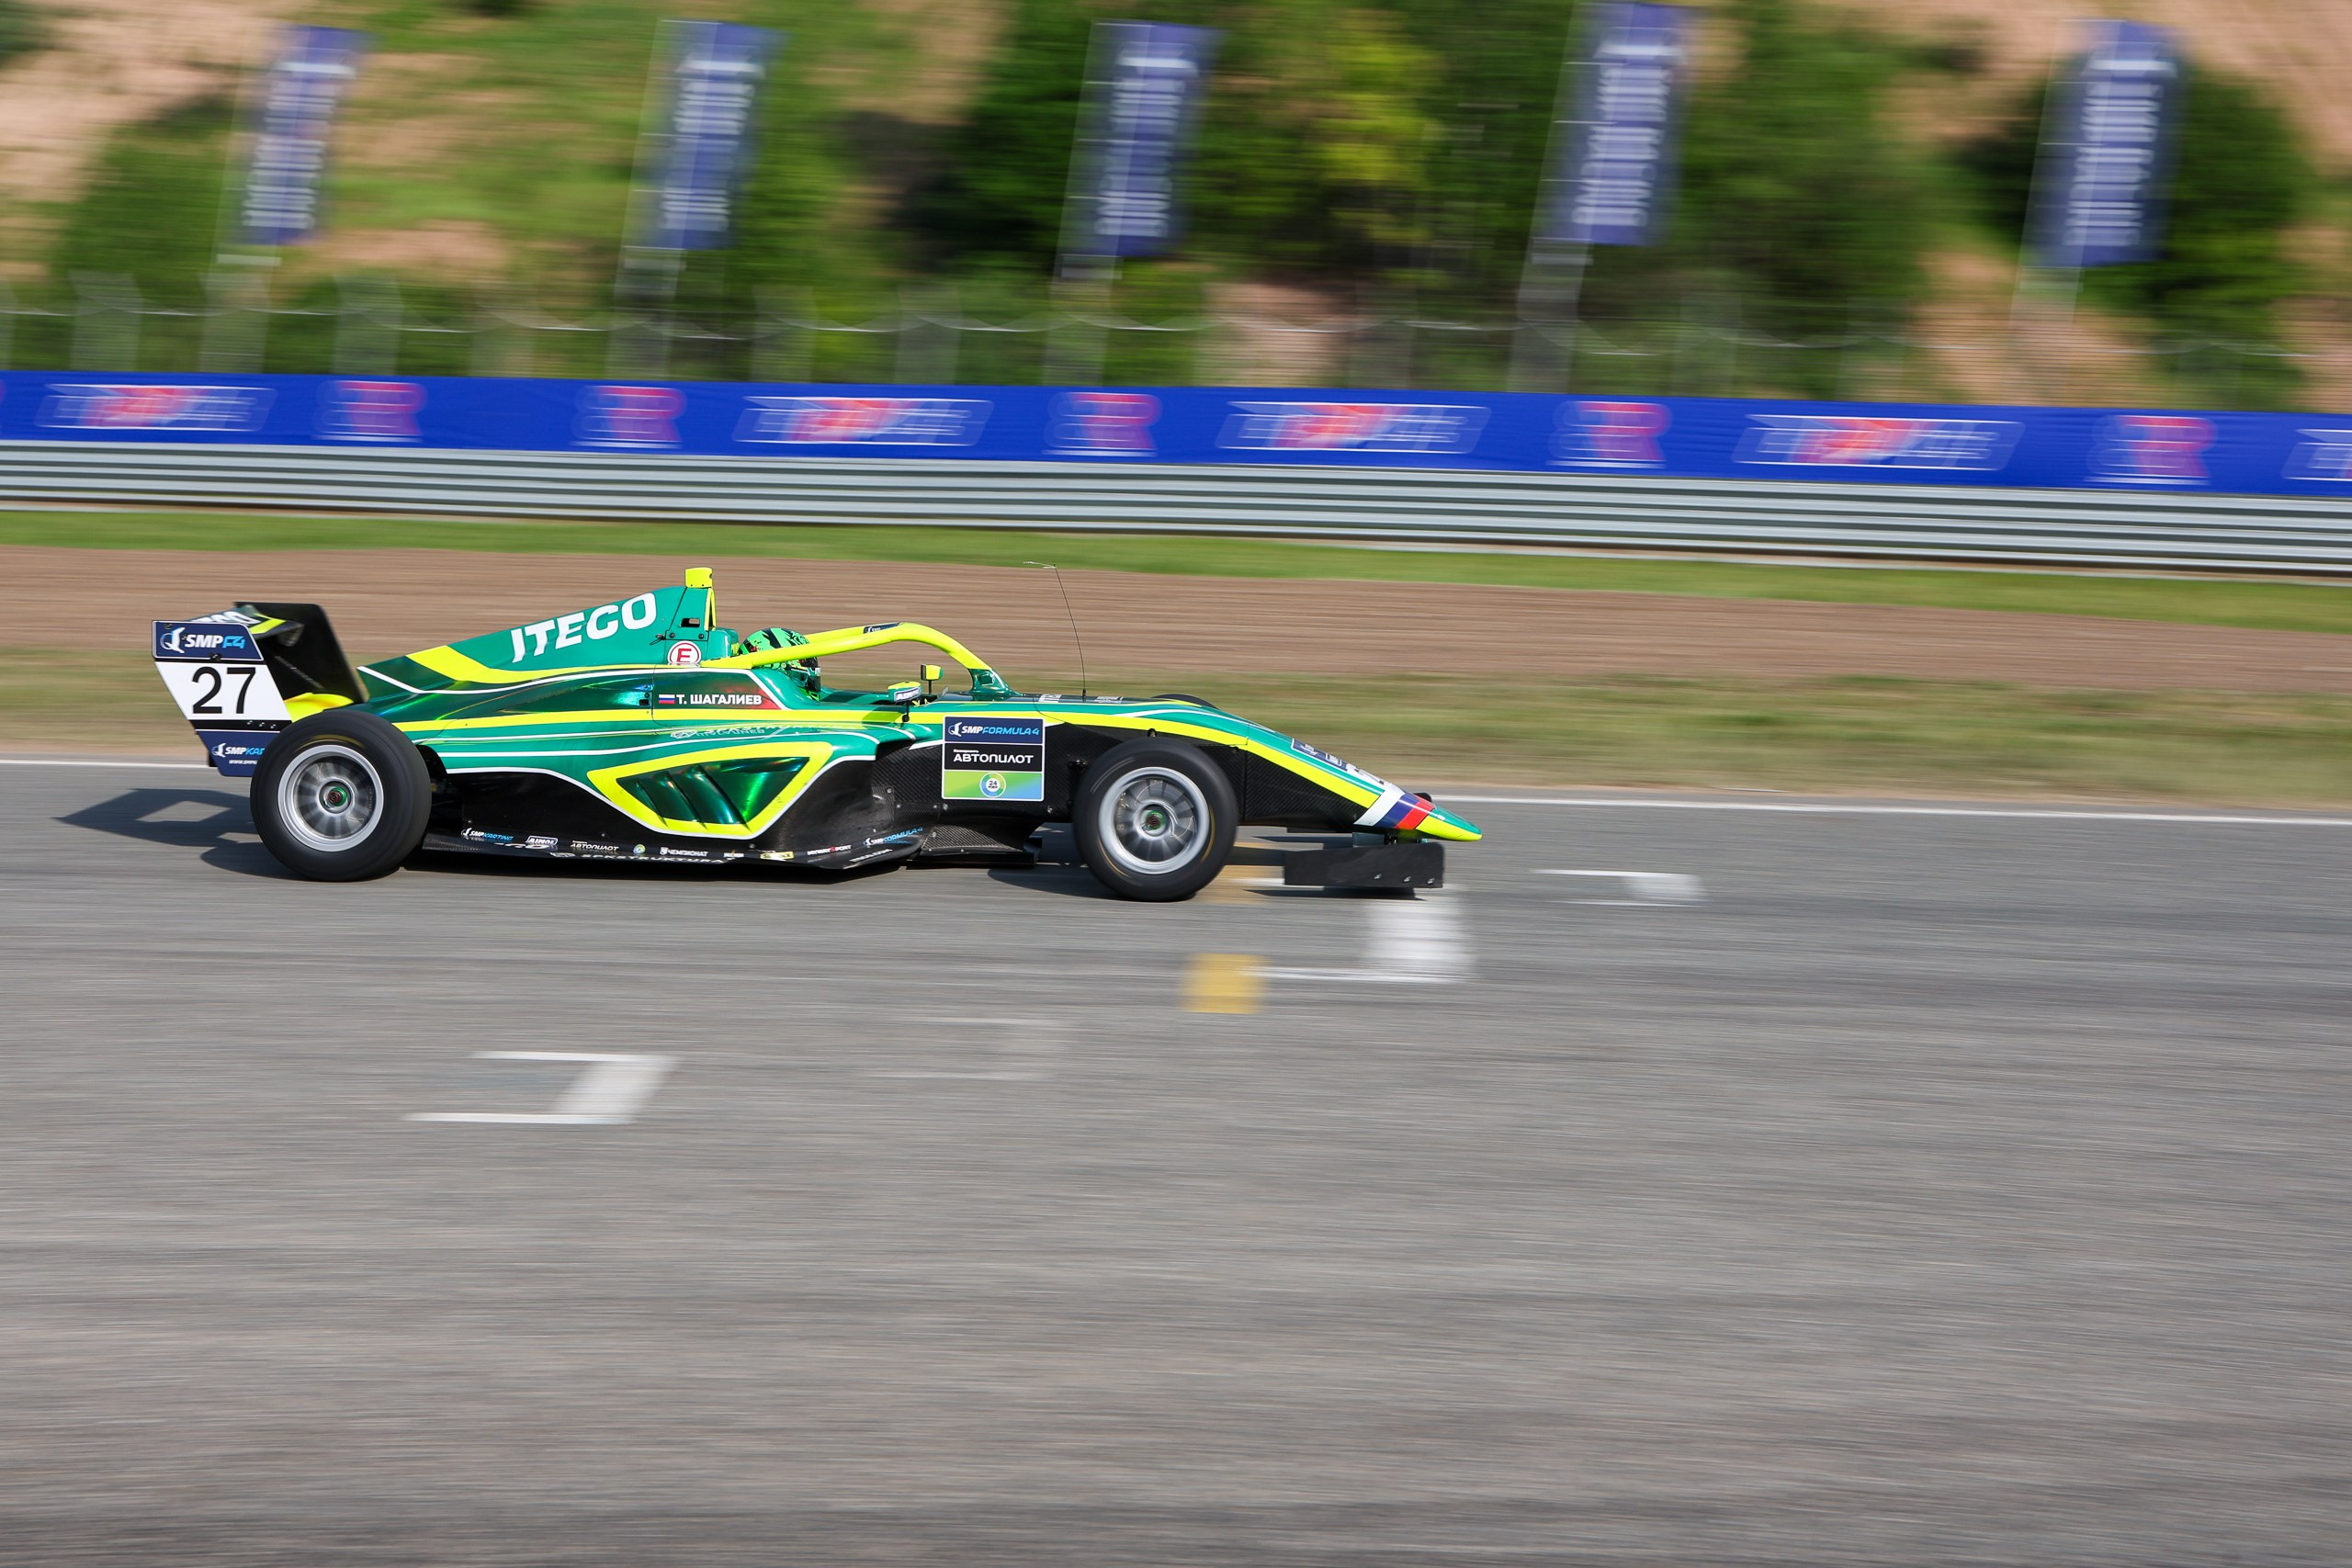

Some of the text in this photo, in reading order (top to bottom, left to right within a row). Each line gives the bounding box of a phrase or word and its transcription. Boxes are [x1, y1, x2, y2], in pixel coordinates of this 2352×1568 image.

[511, 592, 658, 663] ITECO
[677, 648, 692, 662] E
[191, 666, 256, 715] 27
[676, 694, 763, 705] Т. ШАГАЛИЕВ
[953, 753, 1035, 764] АВТОПИЛОТ
